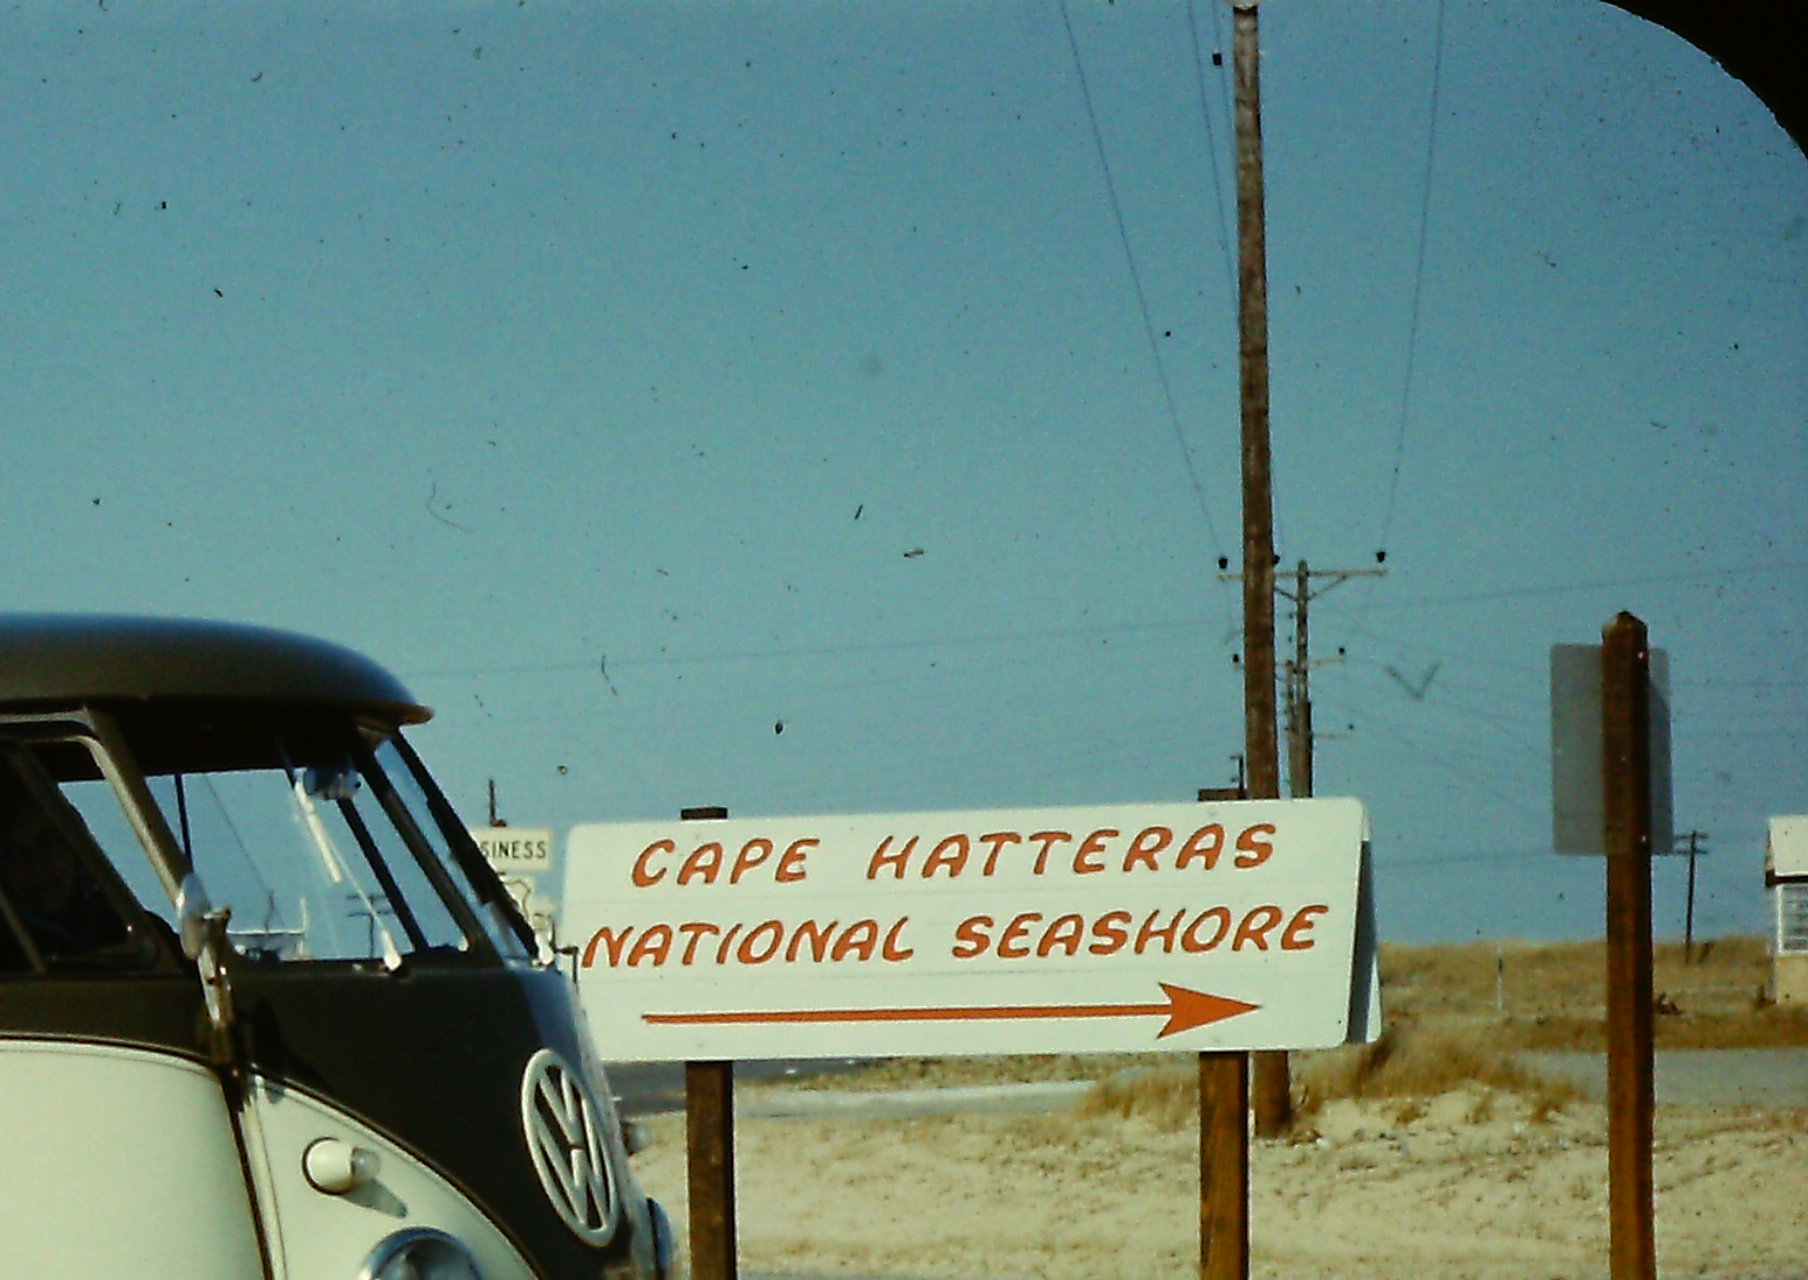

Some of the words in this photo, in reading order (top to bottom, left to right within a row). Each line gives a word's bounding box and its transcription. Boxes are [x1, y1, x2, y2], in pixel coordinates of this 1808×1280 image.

[632, 837, 818, 888] CAPE
[868, 823, 1275, 879] HATTERAS
[583, 916, 913, 969] NATIONAL
[953, 905, 1328, 959] SEASHORE
[522, 1047, 619, 1247] VW
